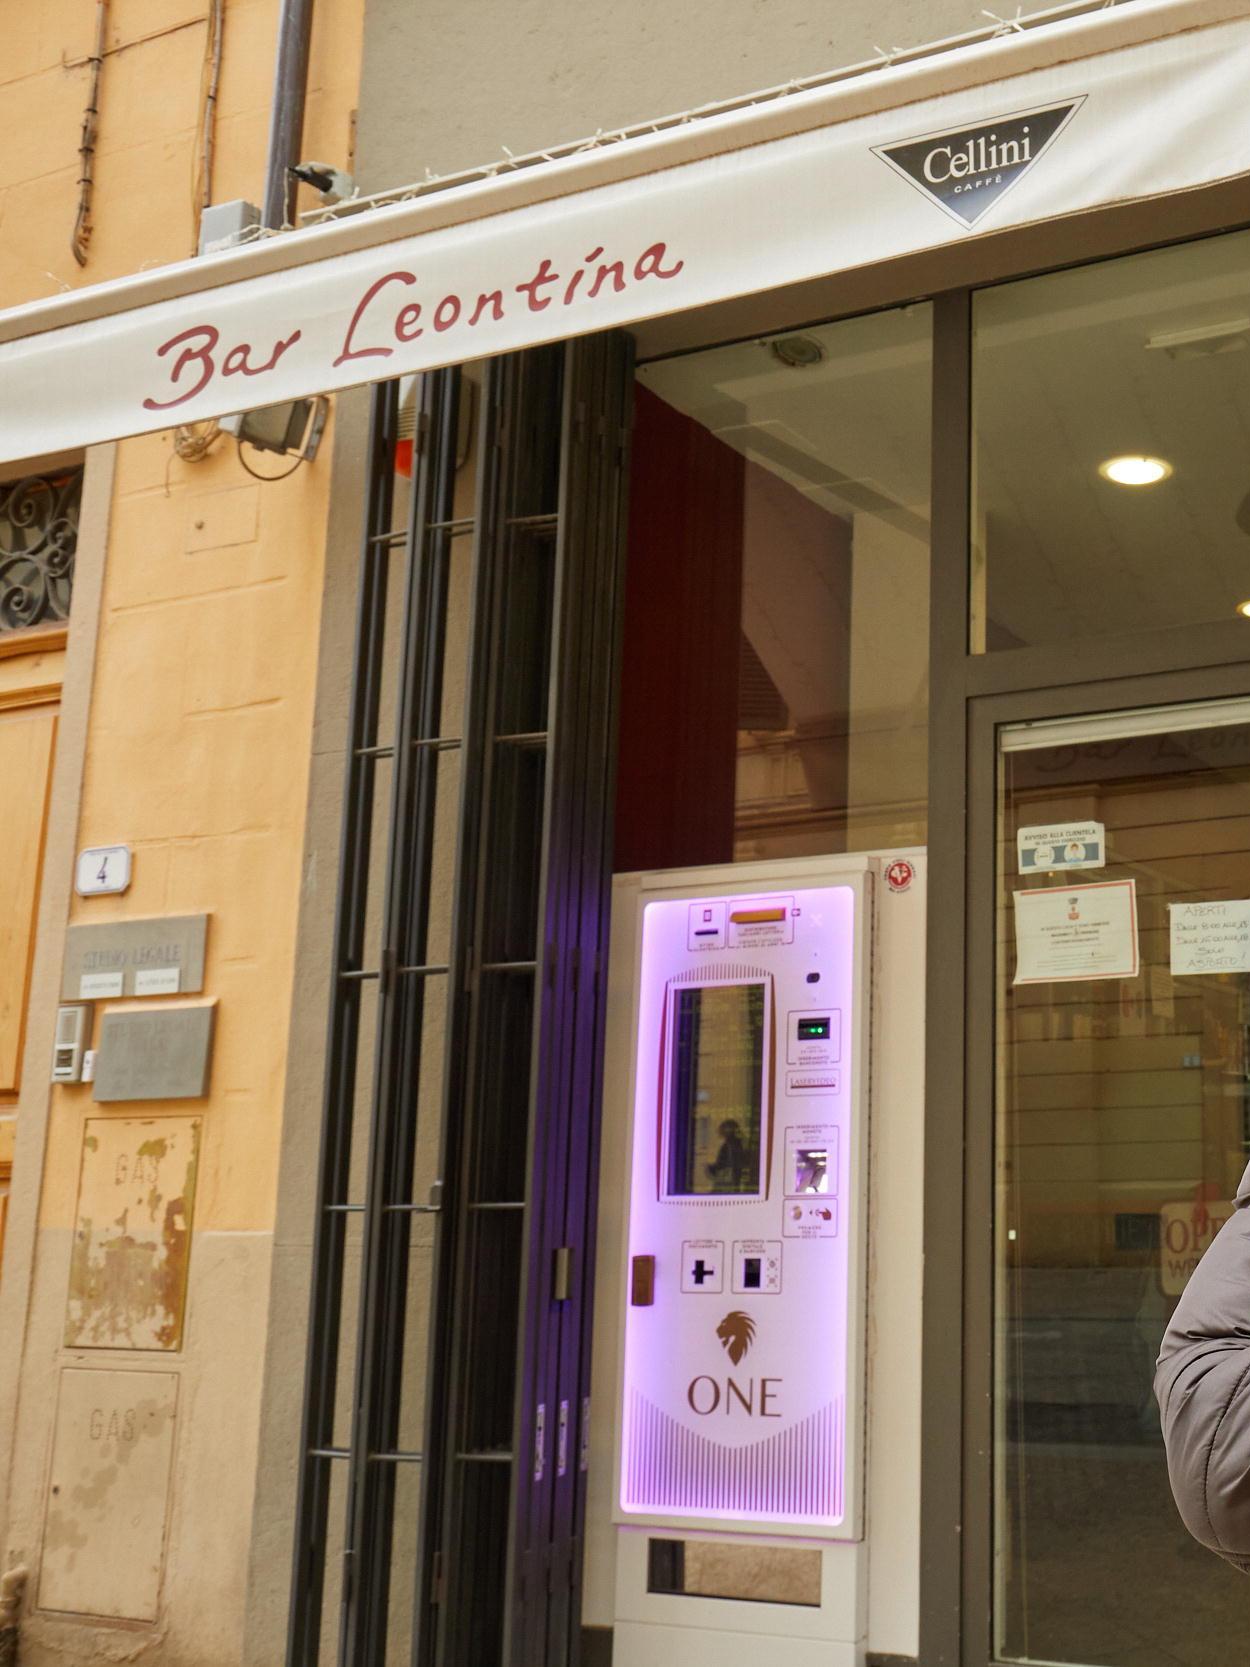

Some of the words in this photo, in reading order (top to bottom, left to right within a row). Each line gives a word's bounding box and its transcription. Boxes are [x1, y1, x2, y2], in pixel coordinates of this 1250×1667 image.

[923, 126, 1032, 183] Cellini
[954, 174, 1002, 194] CAFFÈ
[143, 325, 301, 409] Bar
[333, 242, 684, 367] Leontina
[96, 856, 109, 884] 4
[687, 1375, 783, 1418] ONE
[89, 1408, 136, 1442] GAS
